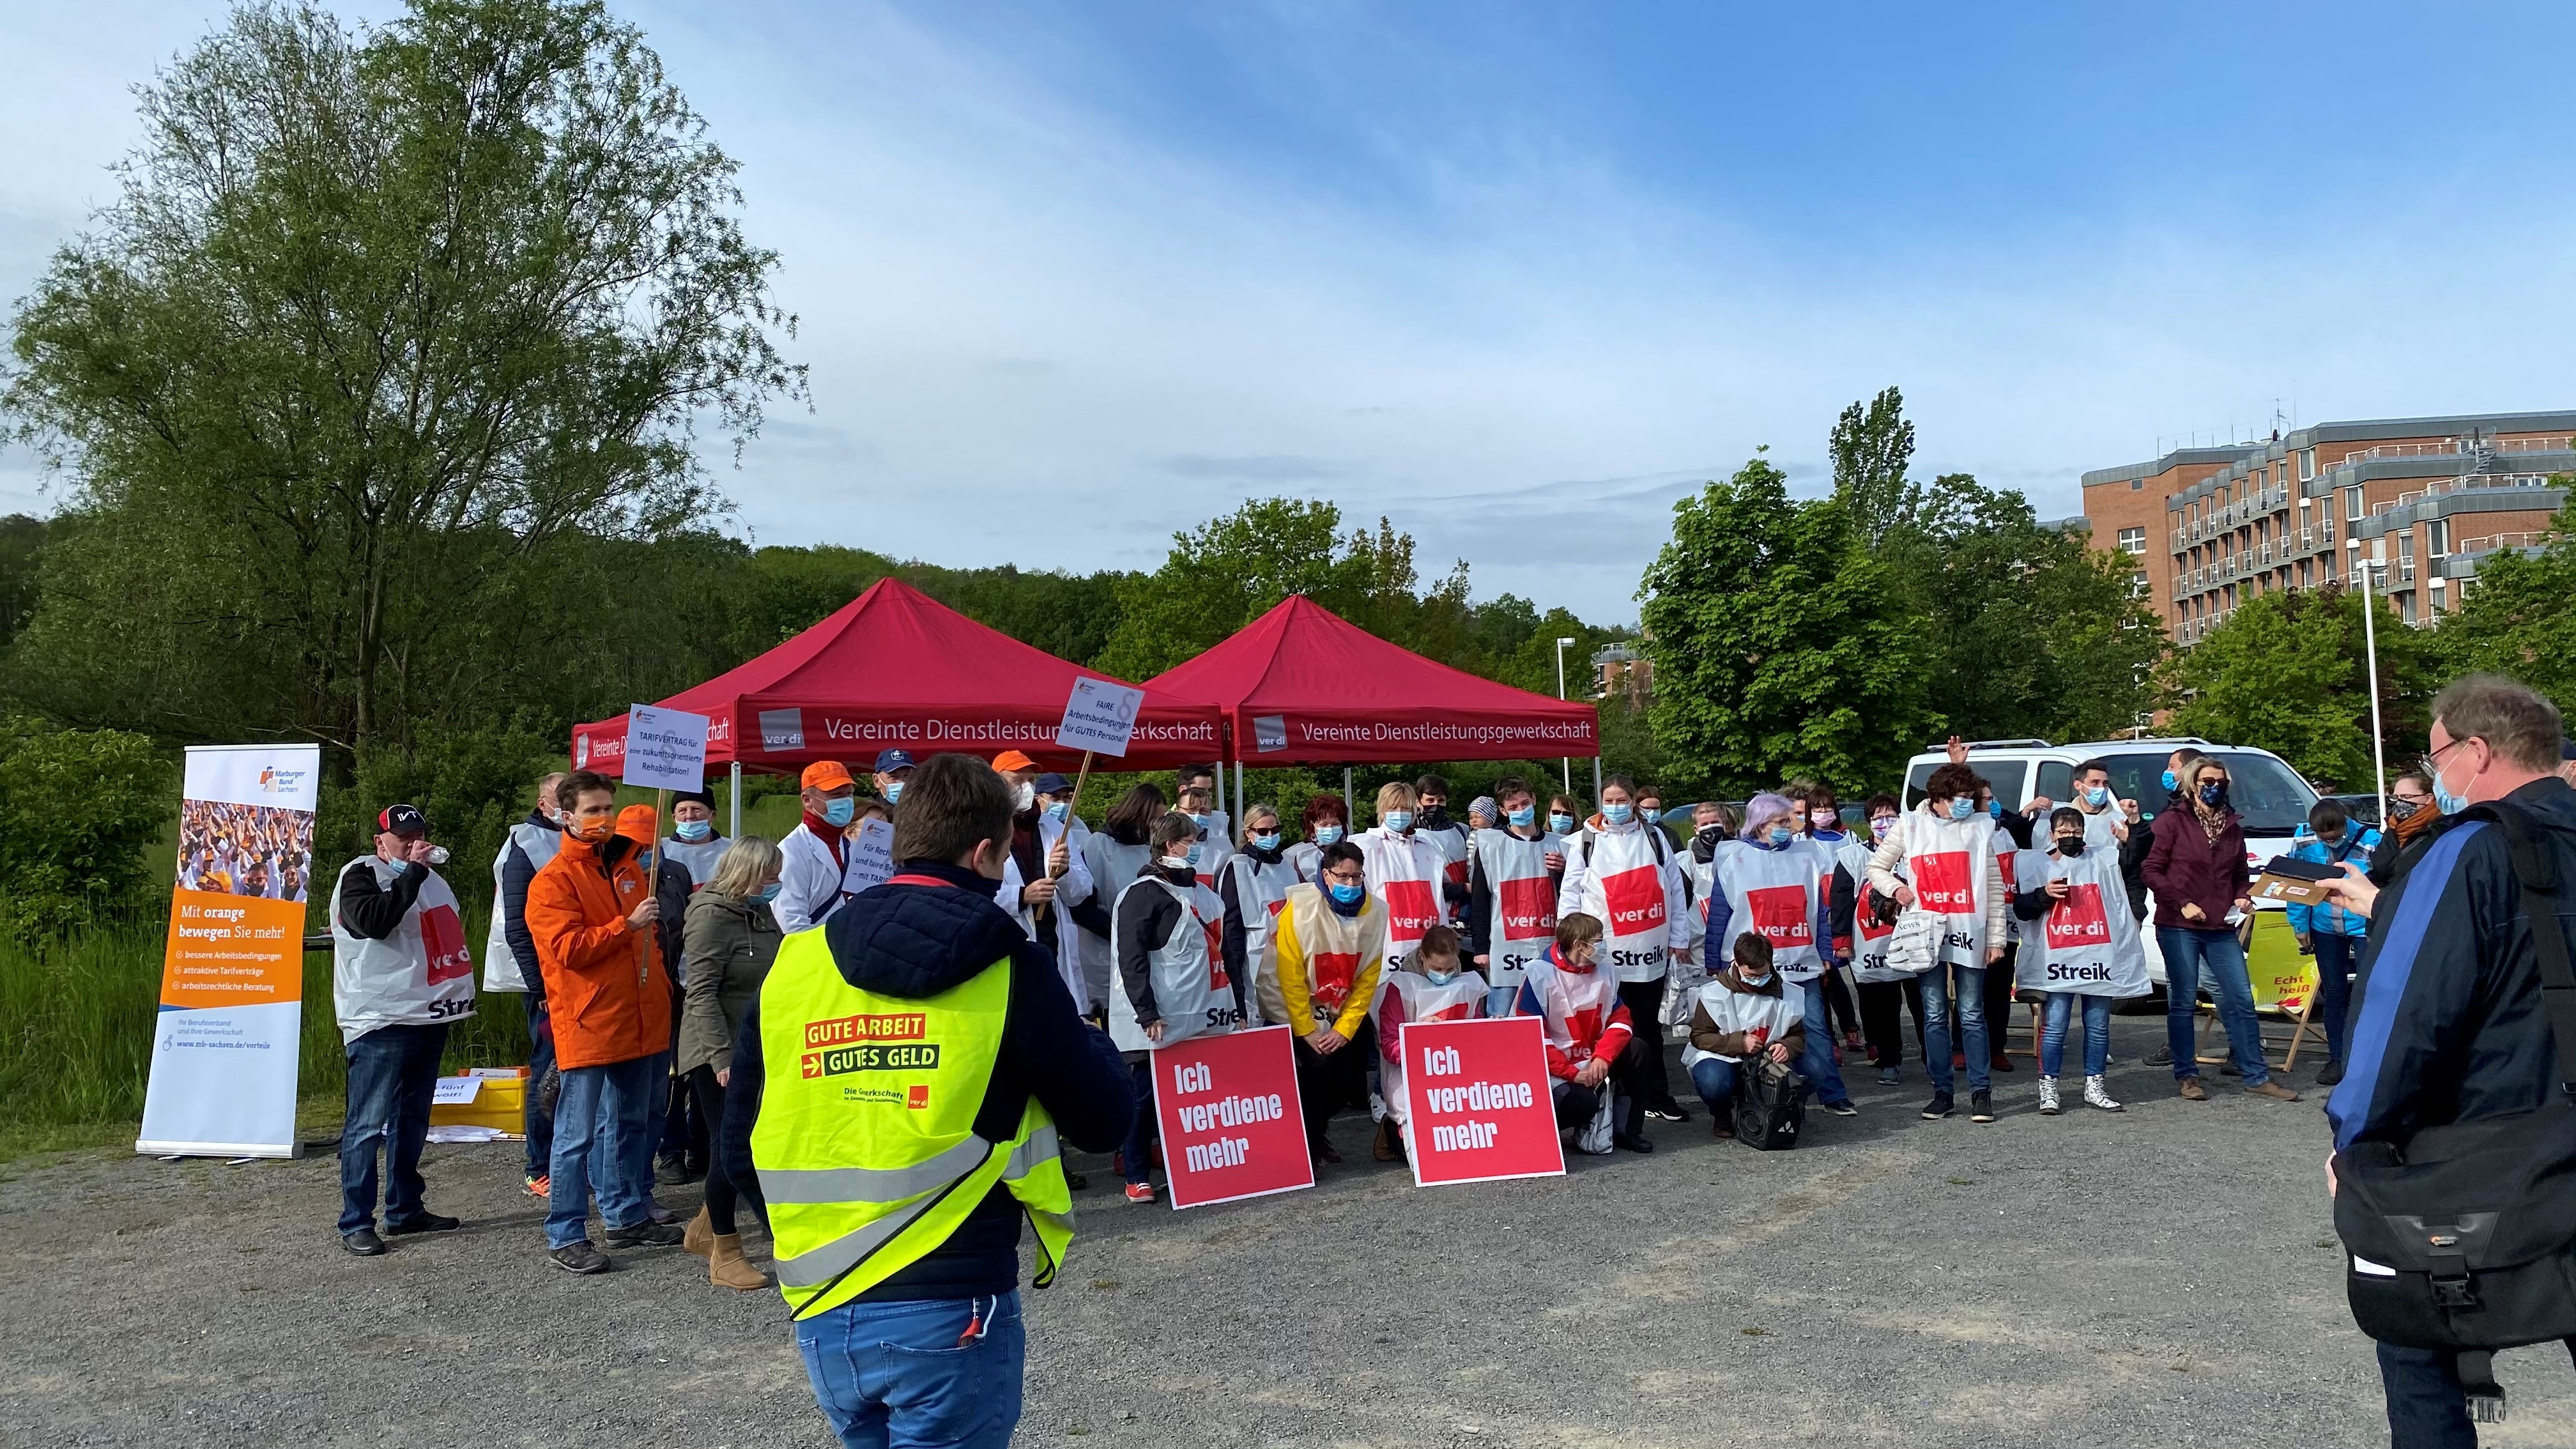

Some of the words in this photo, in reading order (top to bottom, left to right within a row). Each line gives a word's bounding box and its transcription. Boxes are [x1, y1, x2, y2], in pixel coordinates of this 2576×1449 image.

[1096, 700, 1114, 711] FAIRE
[1068, 709, 1131, 729] Arbeitsbedingungen
[825, 718, 919, 740] Vereinte
[1064, 723, 1074, 732] für
[1075, 726, 1096, 737] GUTES
[1301, 723, 1370, 741] Vereinte
[1375, 721, 1591, 744] Dienstleistungsgewerkschaft
[593, 739, 619, 758] Vereinte
[640, 732, 687, 746] TARIFVERTRAG
[688, 739, 698, 747] für
[642, 748, 702, 763] zukunftsorientierte
[275, 770, 305, 778] Marburger
[642, 762, 689, 776] Rehabilitation!
[864, 843, 875, 852] Für
[855, 857, 869, 866] und
[858, 872, 869, 880] mit
[181, 905, 201, 918] Mit
[204, 907, 245, 923] orange
[1614, 902, 1662, 923] ver.di
[178, 924, 231, 942] bewegen
[234, 925, 252, 938] Sie
[254, 926, 285, 939] mehr!
[2050, 921, 2105, 936] ver.di
[185, 951, 213, 960] bessere
[214, 951, 282, 962] Arbeitsbedingungen
[1611, 945, 1664, 966] Streik
[183, 967, 218, 975] attraktive
[220, 967, 264, 977] Tarifverträge
[2047, 962, 2112, 981] Streik
[2274, 975, 2304, 985] Echt
[181, 982, 241, 990] arbeitsrechtliche
[243, 983, 275, 993] Beratung
[2279, 985, 2310, 995] heiß
[203, 1028, 244, 1036] Gewerkschaft
[808, 1020, 853, 1044] GUTE
[856, 1016, 923, 1037] ARBEIT
[829, 1048, 880, 1072] GUTES
[887, 1047, 936, 1066] GELD
[1424, 1045, 1460, 1077] Ich
[1174, 1061, 1212, 1095] Ich
[1426, 1080, 1533, 1115] verdiene
[1178, 1093, 1283, 1133] verdiene
[1432, 1119, 1498, 1152] mehr
[1185, 1136, 1250, 1174] mehr
